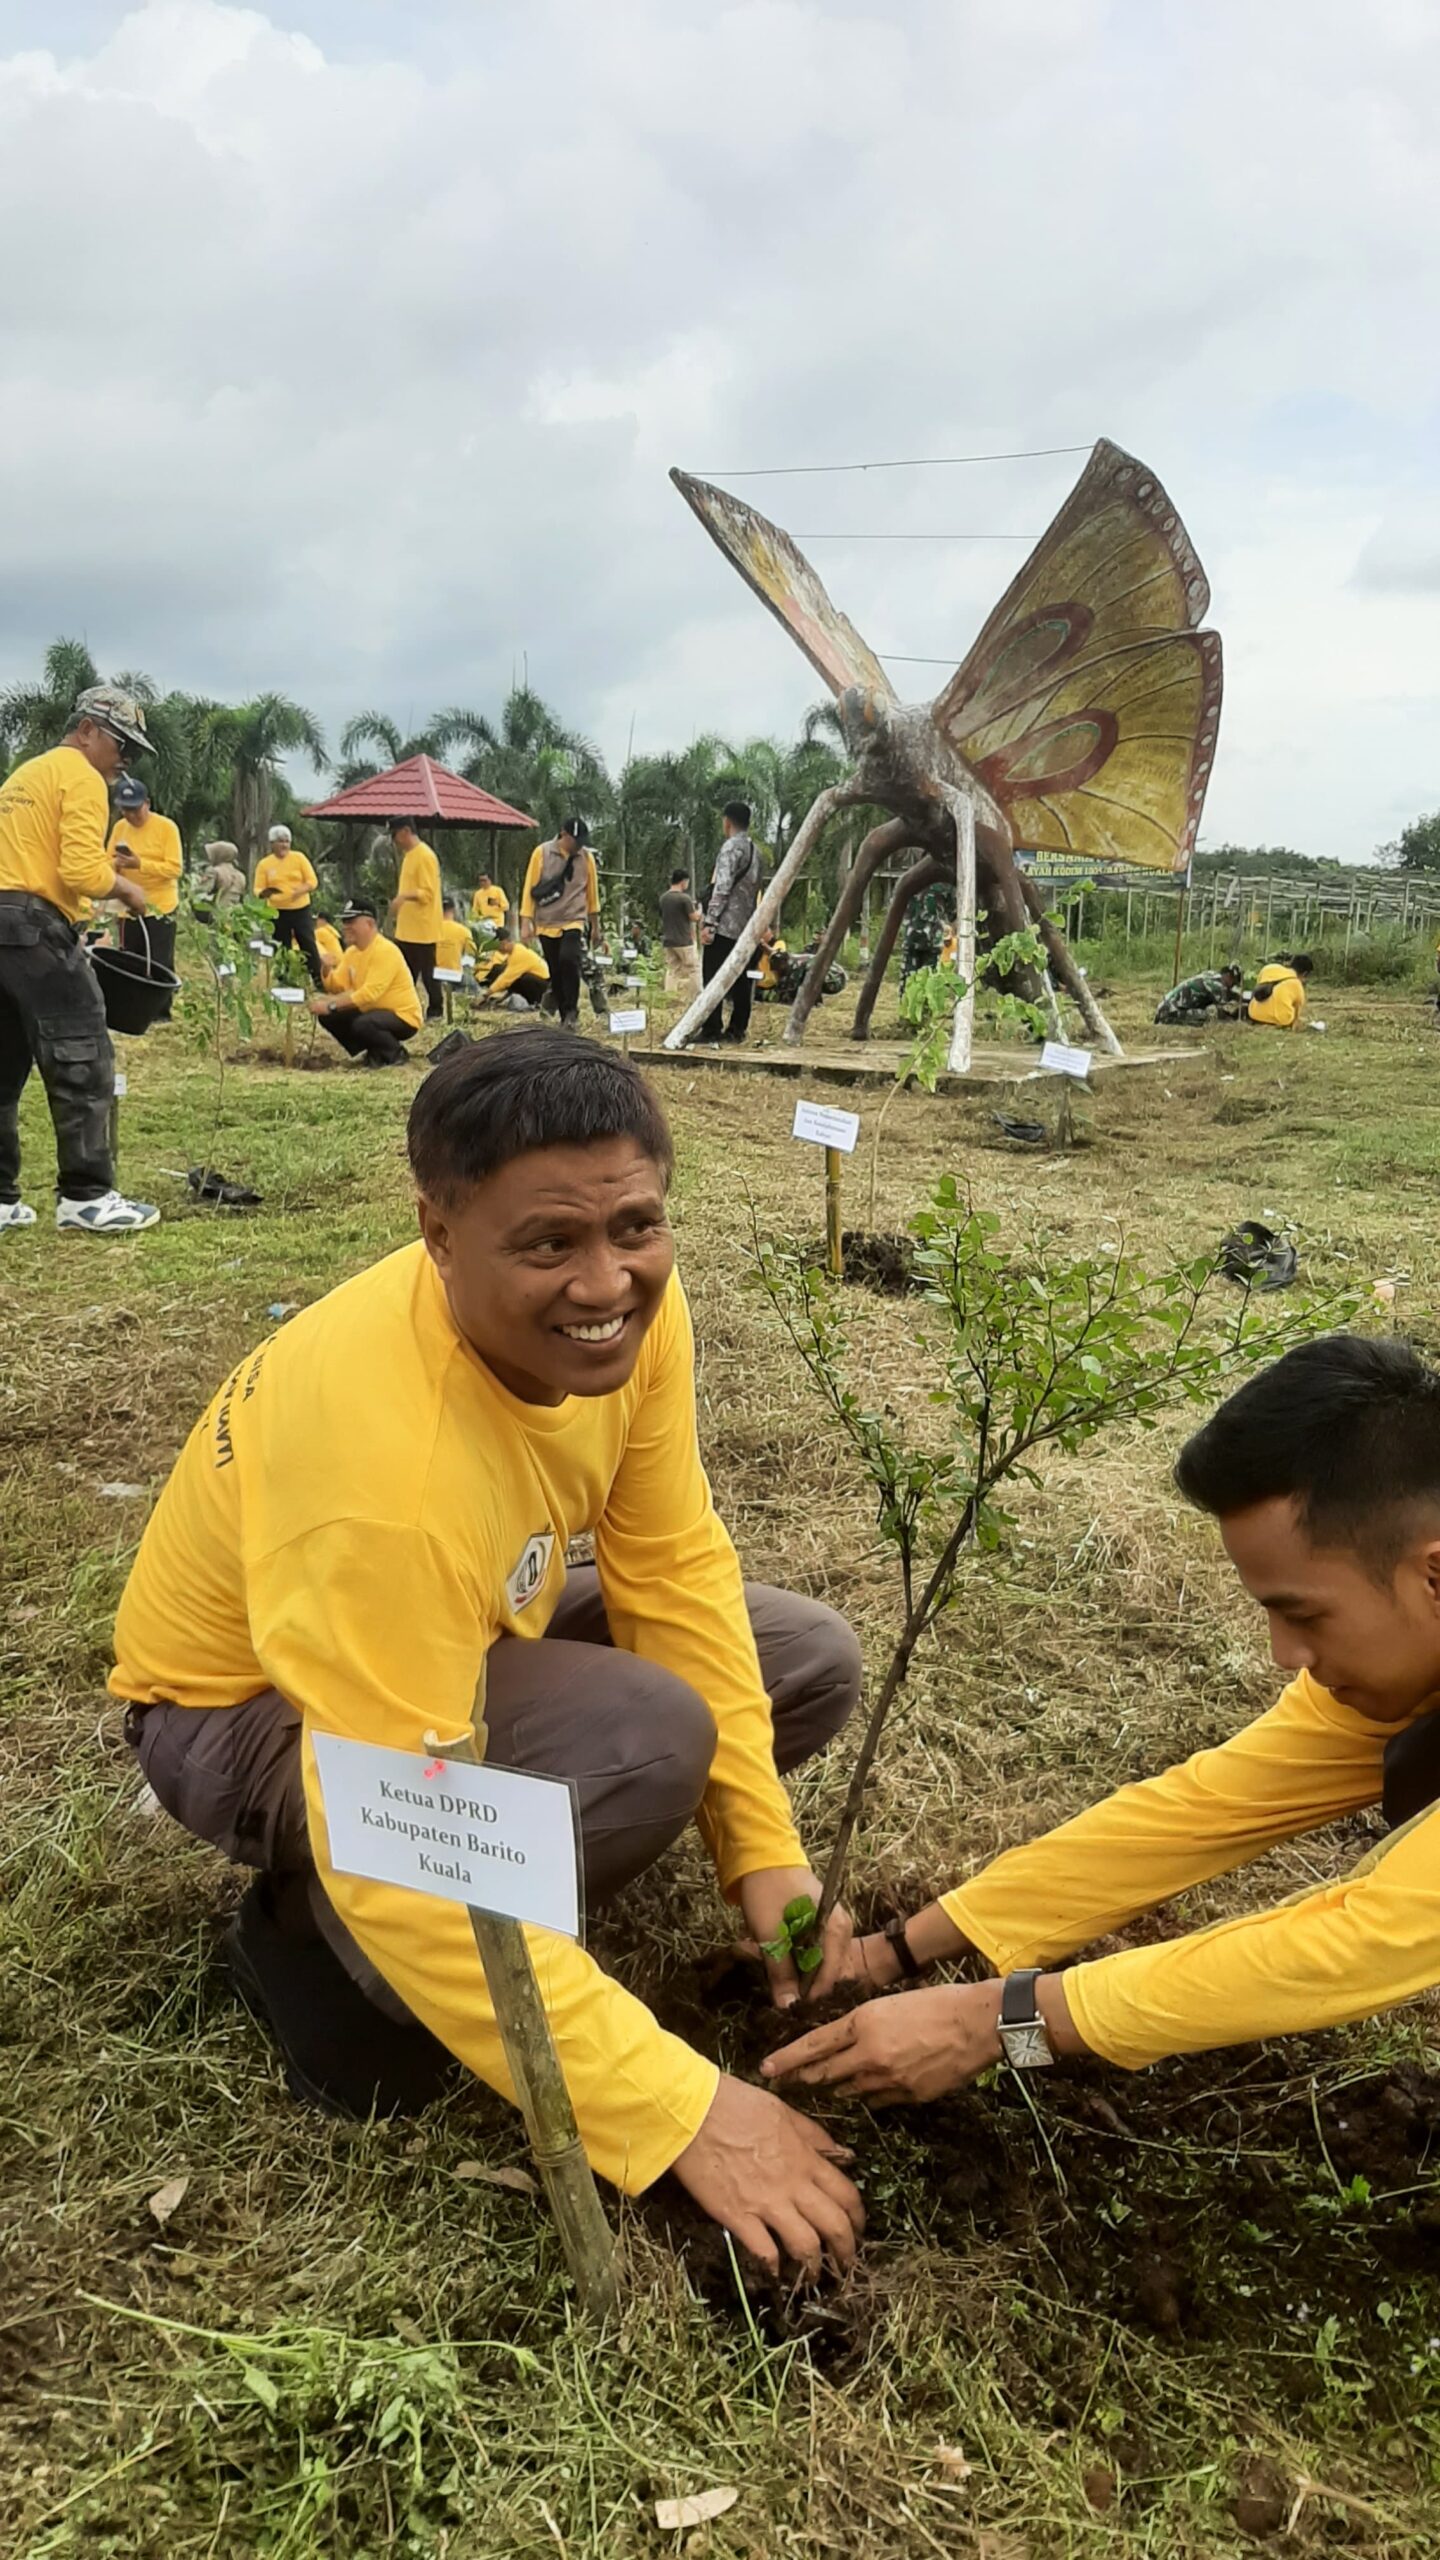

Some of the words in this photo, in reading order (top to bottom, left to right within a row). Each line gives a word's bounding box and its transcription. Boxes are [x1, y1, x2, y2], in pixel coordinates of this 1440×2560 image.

[379, 1780, 434, 1809] Ketua
[440, 1795, 498, 1823] DPRD
[361, 1807, 461, 1848] Kabupaten
[467, 1833, 526, 1865] Barito
[419, 1853, 472, 1884] Kuala
